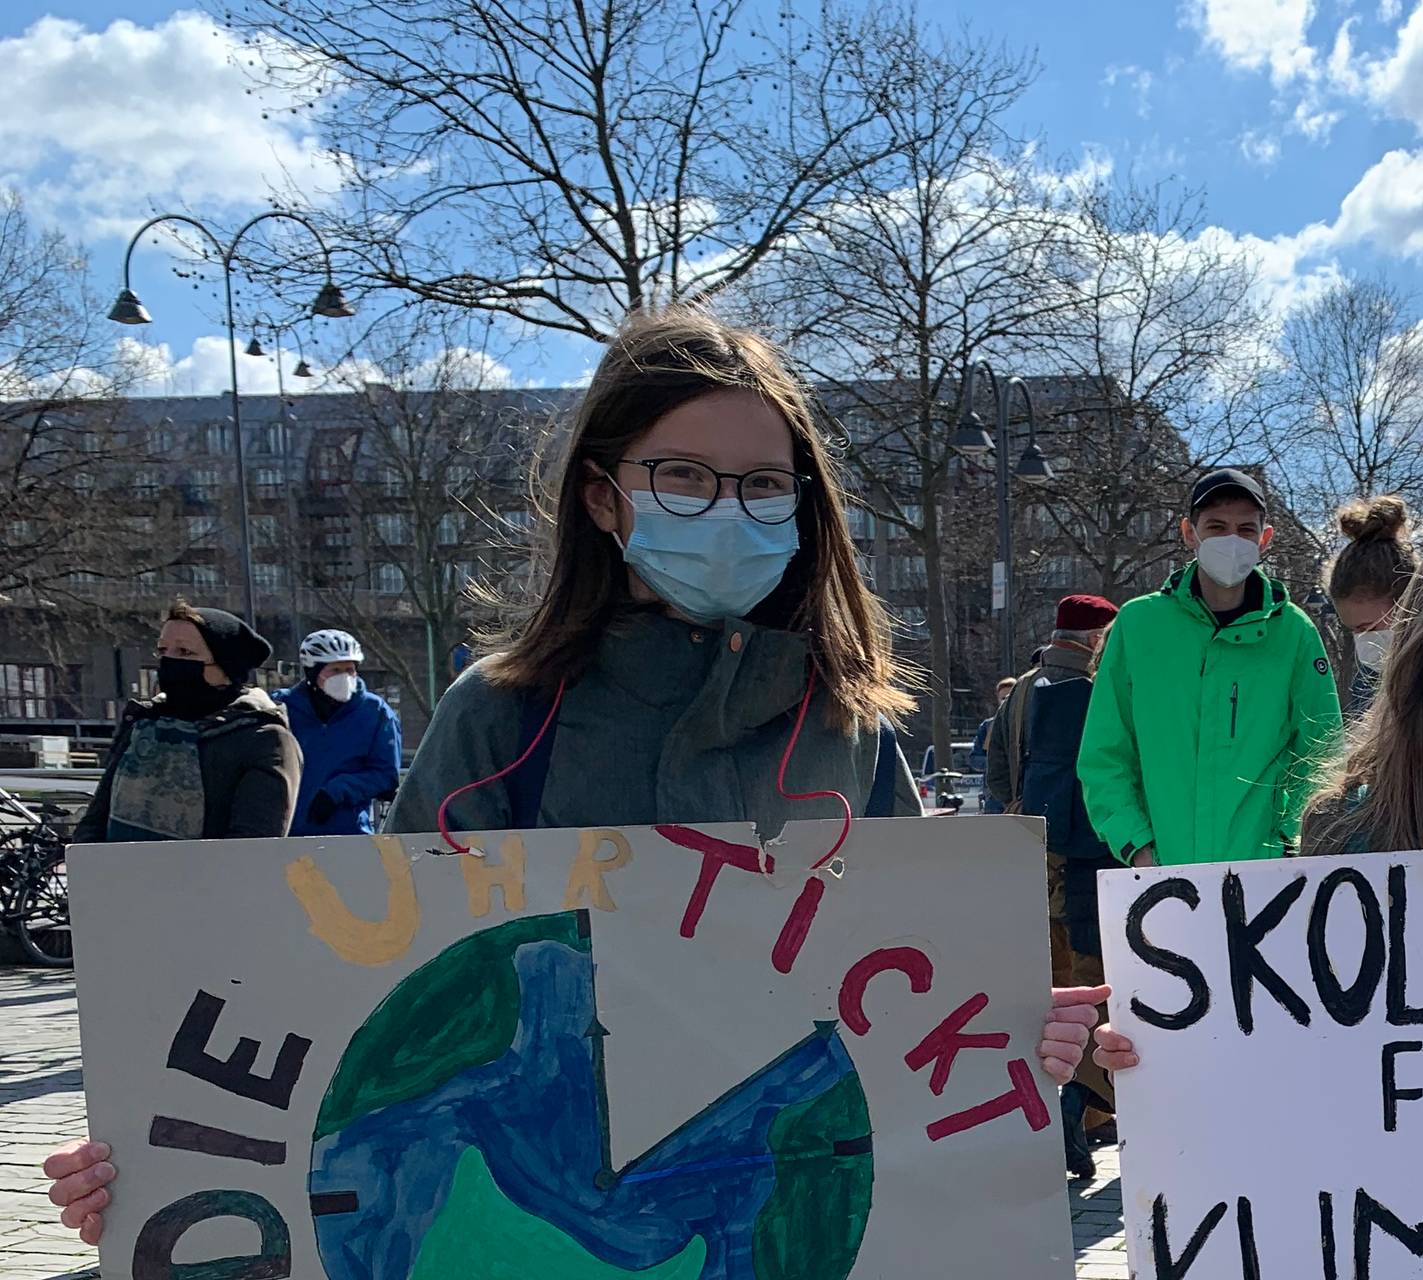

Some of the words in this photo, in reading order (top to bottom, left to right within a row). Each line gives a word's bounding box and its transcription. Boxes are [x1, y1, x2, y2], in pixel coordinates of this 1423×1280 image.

[132, 988, 313, 1280] DIE
[285, 828, 633, 967] UHR
[655, 823, 1051, 1141] TICKT
